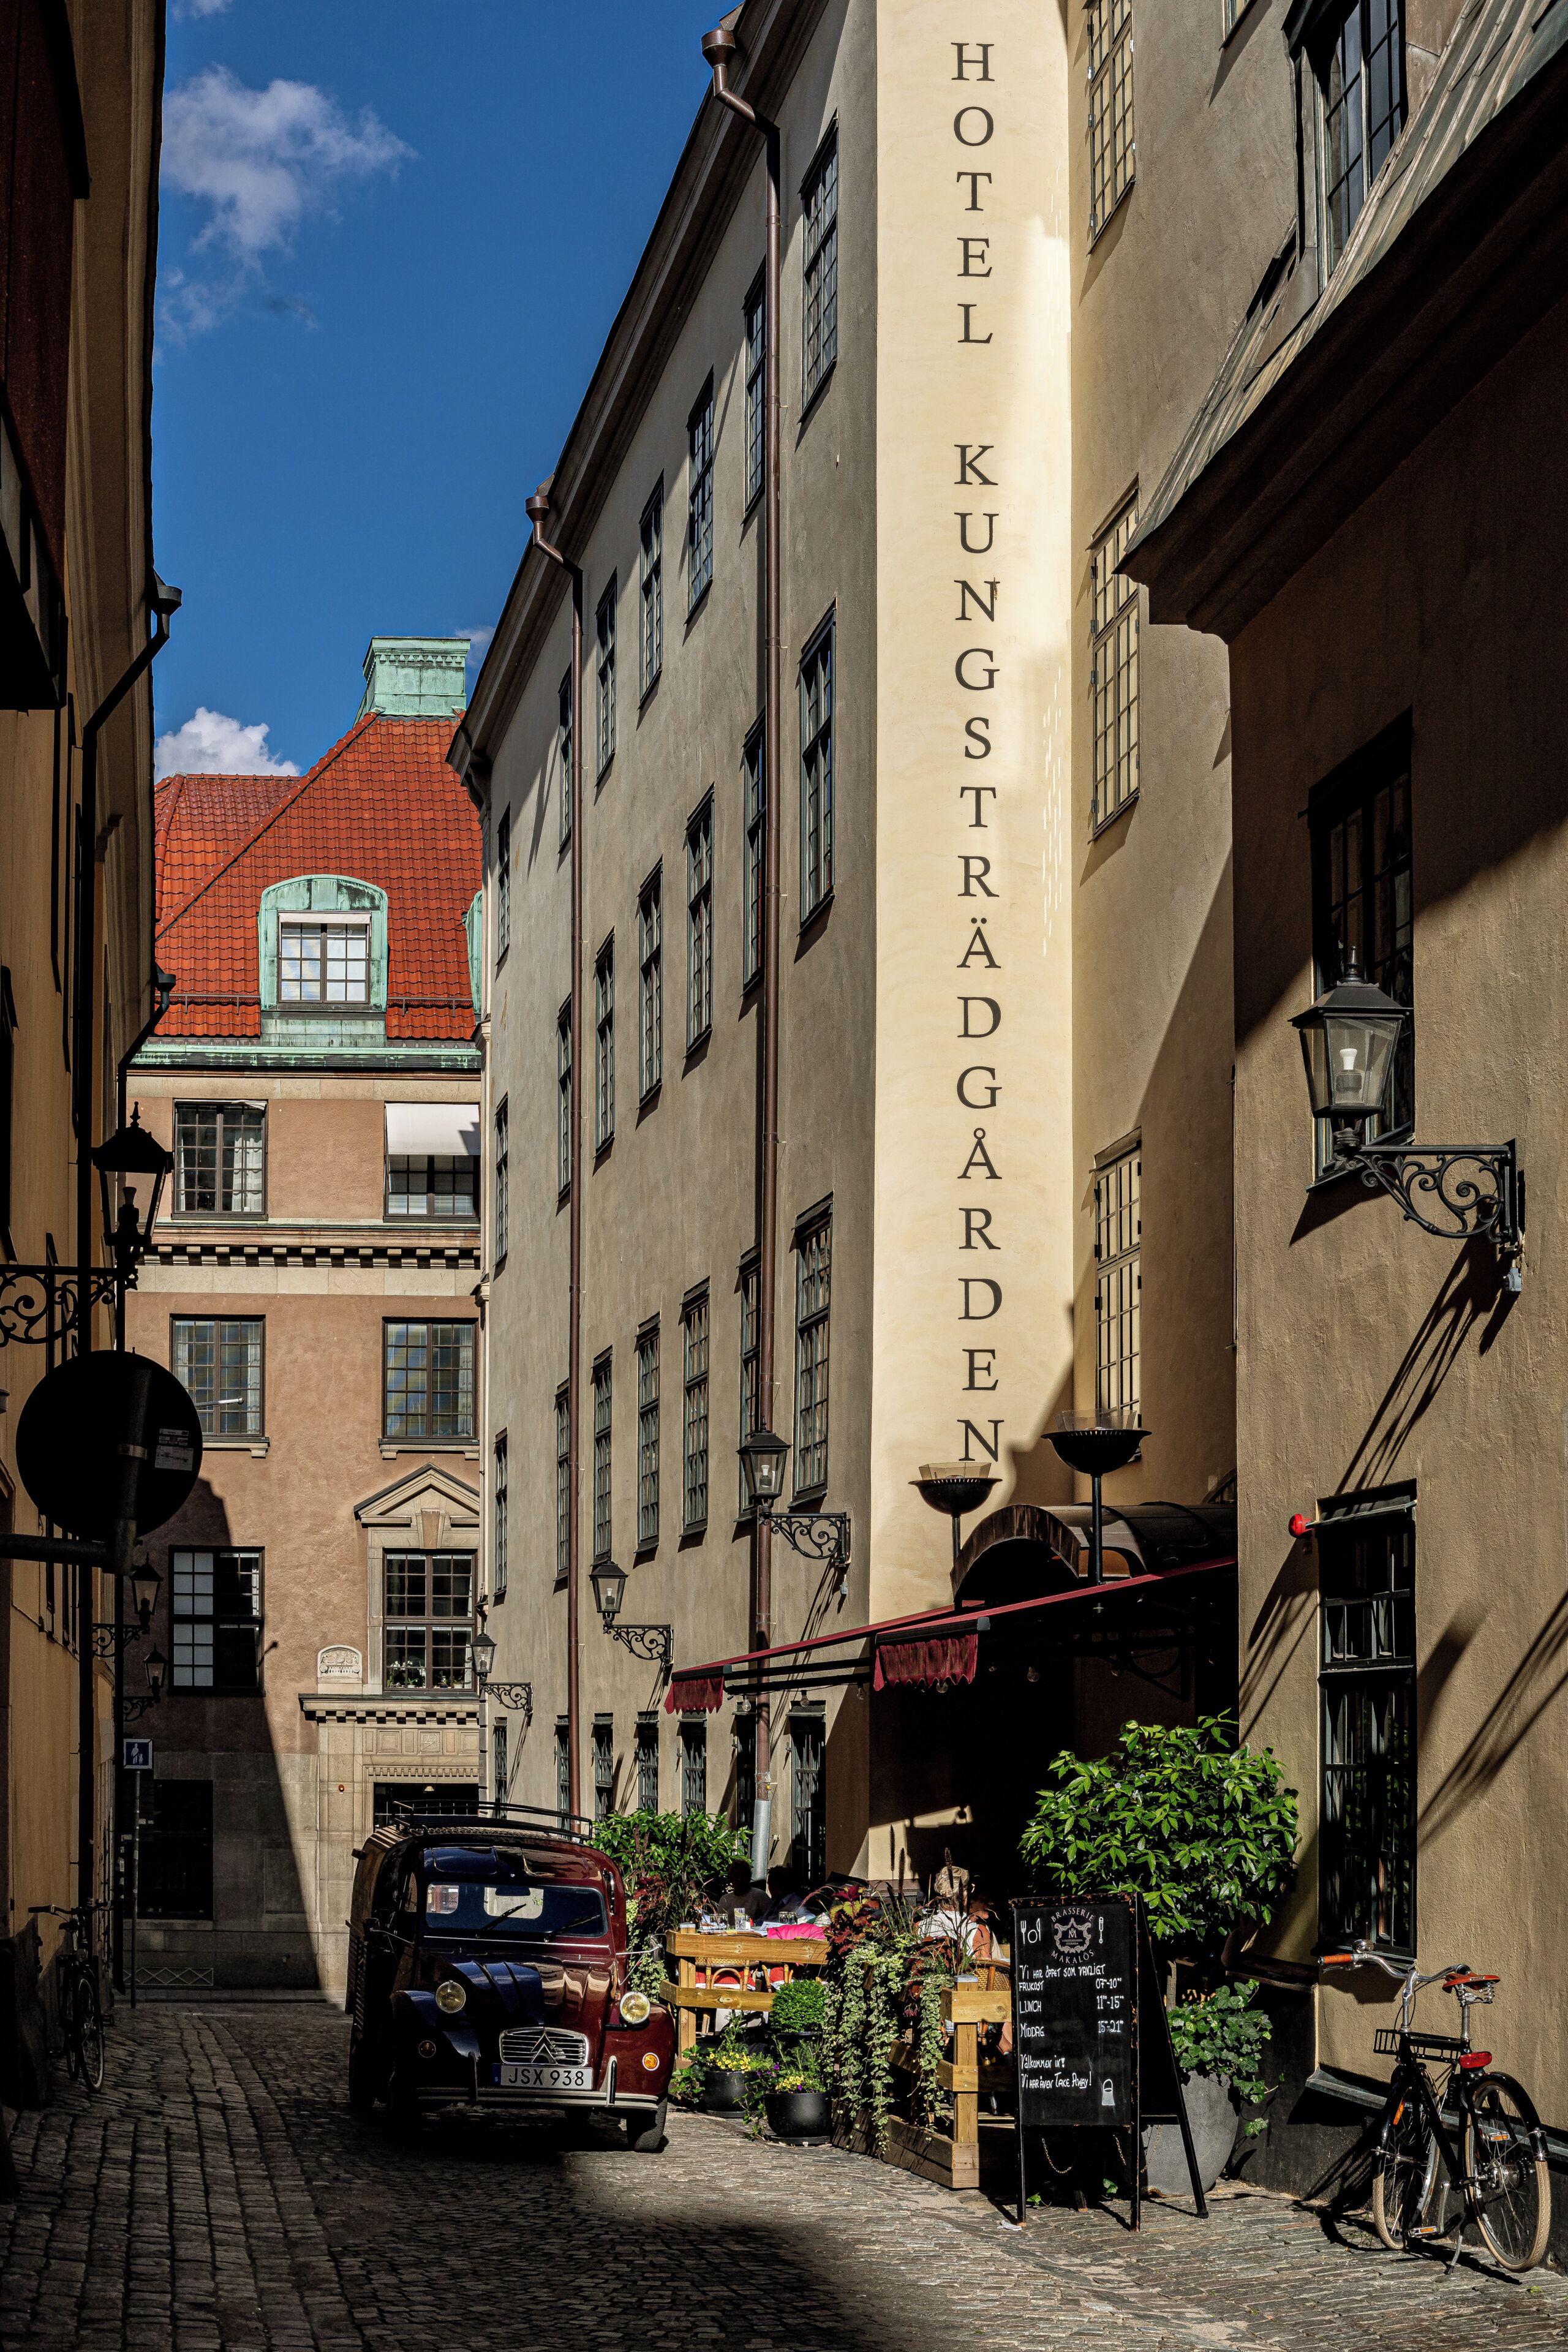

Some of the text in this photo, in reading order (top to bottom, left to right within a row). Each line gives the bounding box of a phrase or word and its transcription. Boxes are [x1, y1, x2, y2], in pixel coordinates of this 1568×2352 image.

[951, 42, 1005, 1463] HOTEL KUNGSTRÄDGÅRDEN
[1051, 1907, 1095, 1923] BRASSERIE
[1051, 1949, 1094, 1964] MAKALÖS
[1019, 1965, 1029, 1980] Vi
[1033, 1969, 1043, 1979] HAR
[1046, 1965, 1061, 1978] ÖPPET
[1063, 1967, 1076, 1977] SOM
[1019, 1980, 1044, 1992] FRUKOST
[1019, 2000, 1042, 2014] LUNCH
[508, 2068, 584, 2086] JSX 938
[1021, 2073, 1028, 2089] Vi
[1029, 2080, 1039, 2089] HAR
